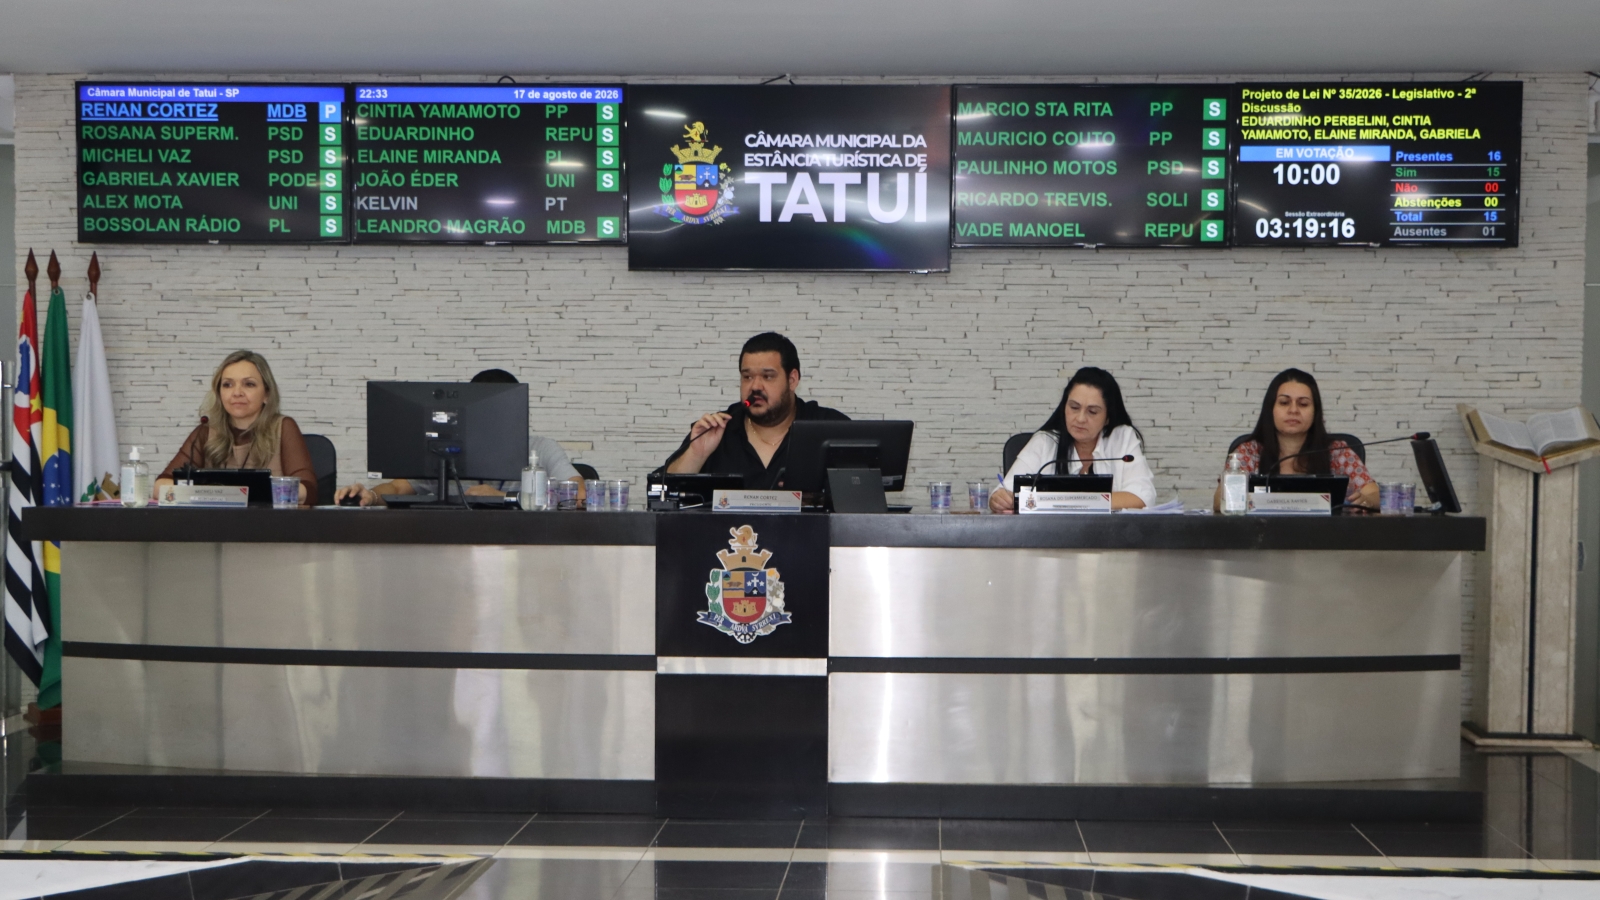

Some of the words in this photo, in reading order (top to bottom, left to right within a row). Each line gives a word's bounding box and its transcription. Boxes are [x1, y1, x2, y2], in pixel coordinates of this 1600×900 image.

[87, 88, 125, 97] Câmara
[128, 88, 175, 98] Municipal
[178, 88, 190, 97] de
[225, 89, 239, 97] SP
[360, 89, 388, 98] 22:33
[514, 90, 525, 99] 17
[528, 90, 540, 99] de
[543, 91, 577, 101] agosto
[580, 90, 592, 99] de
[595, 91, 618, 99] 2026
[1243, 89, 1283, 101] Projeto
[1286, 90, 1300, 99] de
[1303, 90, 1319, 99] Lei
[1339, 90, 1382, 99] 35/2026
[1393, 89, 1454, 101] Legislativo
[81, 103, 142, 117] RENAN
[147, 103, 218, 117] CORTEZ
[267, 104, 307, 118] MDB
[325, 106, 336, 118] P
[357, 104, 415, 118] CINTIA
[419, 104, 520, 118] YAMAMOTO
[546, 105, 568, 118] PP
[602, 106, 613, 120] S
[959, 102, 1029, 116] MARCIO
[1035, 102, 1068, 116] STA
[1074, 102, 1113, 116] RITA
[1150, 102, 1173, 116] PP
[1209, 103, 1220, 116] S
[1242, 103, 1301, 113] Discussão
[1242, 116, 1320, 126] EDUARDINHO
[1324, 116, 1389, 127] PERBELINI,
[1392, 116, 1431, 126] CINTIA
[82, 126, 156, 140] ROSANA
[161, 127, 239, 140] SUPERM.
[268, 127, 303, 141] PSD
[325, 127, 335, 141] S
[358, 127, 474, 141] EDUARDINHO
[546, 128, 592, 141] REPU
[602, 128, 613, 142] S
[744, 130, 813, 148] CÂMARA
[817, 134, 902, 148] MUNICIPAL
[903, 135, 927, 148] DA
[958, 132, 1047, 146] MAURICIO
[1052, 132, 1115, 145] COUTO
[1150, 132, 1172, 145] PP
[1208, 132, 1220, 146] S
[1242, 130, 1311, 141] YAMAMOTO,
[1315, 130, 1356, 139] ELAINE
[1360, 129, 1417, 141] MIRANDA,
[1420, 129, 1480, 139] GABRIELA
[82, 149, 152, 162] MICHELI
[158, 149, 191, 163] VAZ
[269, 150, 303, 164] PSD
[325, 150, 336, 164] S
[358, 150, 418, 163] ELAINE
[424, 150, 501, 163] MIRANDA
[602, 151, 613, 165] S
[744, 150, 822, 166] ESTÂNCIA
[825, 150, 902, 167] TURÍSTICA
[905, 154, 927, 167] DE
[1276, 149, 1293, 158] EM
[1296, 146, 1354, 160] VOTAÇÃO
[1396, 152, 1453, 161] Presentes
[1488, 152, 1501, 161] 16
[958, 161, 1047, 175] PAULINHO
[1053, 161, 1117, 175] MOTOS
[1148, 161, 1183, 175] PSD
[1208, 161, 1219, 175] S
[1273, 164, 1340, 185] 10:00
[1395, 168, 1417, 177] Sim
[1487, 168, 1499, 177] 15
[83, 172, 172, 186] GABRIELA
[176, 173, 239, 186] XAVIER
[269, 173, 316, 186] PODE
[325, 173, 336, 187] S
[357, 170, 405, 186] JOÃO
[411, 170, 458, 187] ÉDER
[546, 174, 574, 187] UNI
[602, 174, 613, 188] S
[1396, 183, 1418, 192] Não
[1485, 183, 1498, 192] 00
[744, 166, 928, 224] TATUÍ
[957, 193, 1038, 207] RICARDO
[1045, 193, 1112, 207] TREVIS.
[1147, 193, 1187, 207] SOLI
[1207, 193, 1218, 207] S
[83, 195, 128, 209] ALEX
[134, 195, 183, 209] MOTA
[269, 196, 297, 210] UNI
[326, 196, 336, 210] S
[357, 197, 418, 210] KELVIN
[546, 198, 567, 211] PT
[1394, 198, 1461, 210] Abstenções
[1484, 198, 1498, 207] 00
[84, 218, 180, 232] BOSSOLAN
[186, 214, 240, 232] RÁDIO
[269, 219, 290, 232] PL
[326, 219, 337, 233] S
[1395, 212, 1422, 221] Total
[1484, 212, 1497, 221] 15
[357, 220, 441, 233] LEANDRO
[448, 217, 525, 234] MAGRÃO
[547, 221, 585, 234] MDB
[602, 220, 613, 234] S
[957, 224, 1003, 237] VADE
[1009, 224, 1085, 237] MANOEL
[1145, 224, 1193, 237] REPU
[1206, 224, 1218, 237] S
[1256, 218, 1355, 238] 03:19:16
[1394, 227, 1446, 236] Ausentes
[1483, 227, 1495, 236] 01
[714, 614, 724, 625] PER
